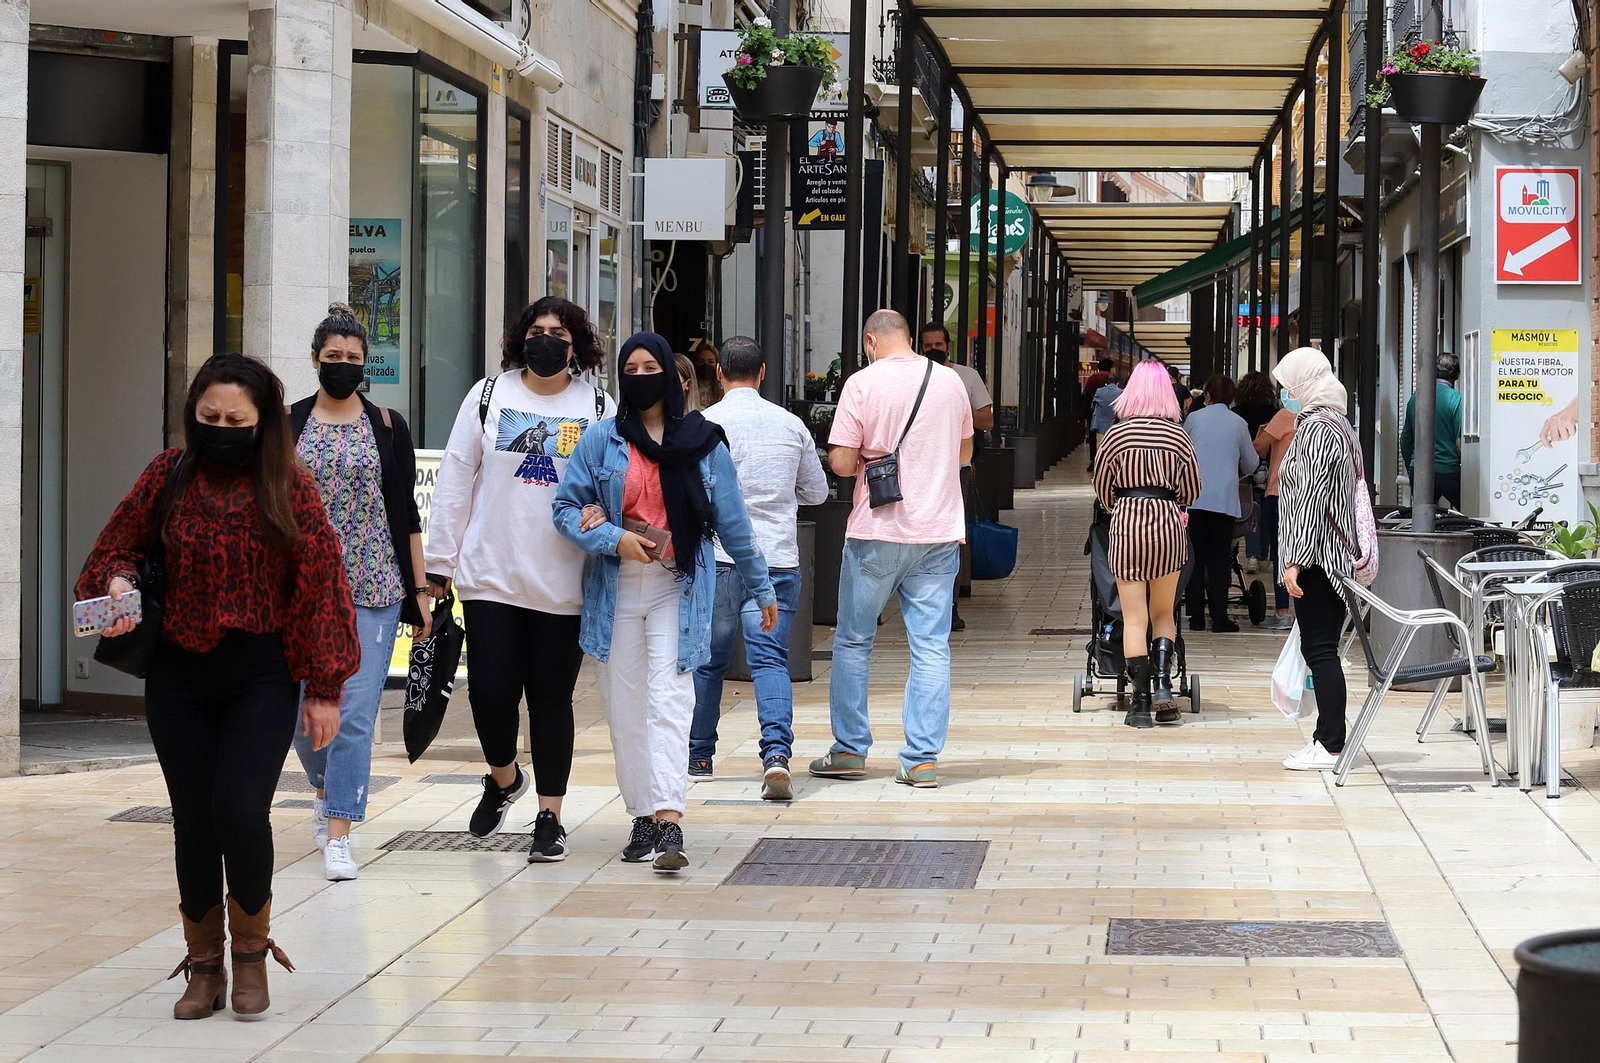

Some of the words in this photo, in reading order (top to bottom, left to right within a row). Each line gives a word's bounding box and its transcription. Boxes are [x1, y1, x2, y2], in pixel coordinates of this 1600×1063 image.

[806, 179, 827, 187] Arreglo
[1508, 206, 1567, 215] MOVILCITY
[820, 214, 829, 222] EN
[349, 246, 376, 255] puelas
[1511, 331, 1558, 342] MÁSMÓVL
[688, 337, 703, 352] 7
[1498, 358, 1536, 366] NUESTRA
[1537, 358, 1564, 367] FIBRA,
[1509, 368, 1540, 376] MEJOR
[1541, 368, 1574, 376] MOTOR
[1498, 380, 1525, 388] PARA
[1526, 380, 1538, 388] TU
[1498, 393, 1544, 401] NEGOCIO
[522, 454, 555, 469] STAR
[514, 464, 560, 484] WARS
